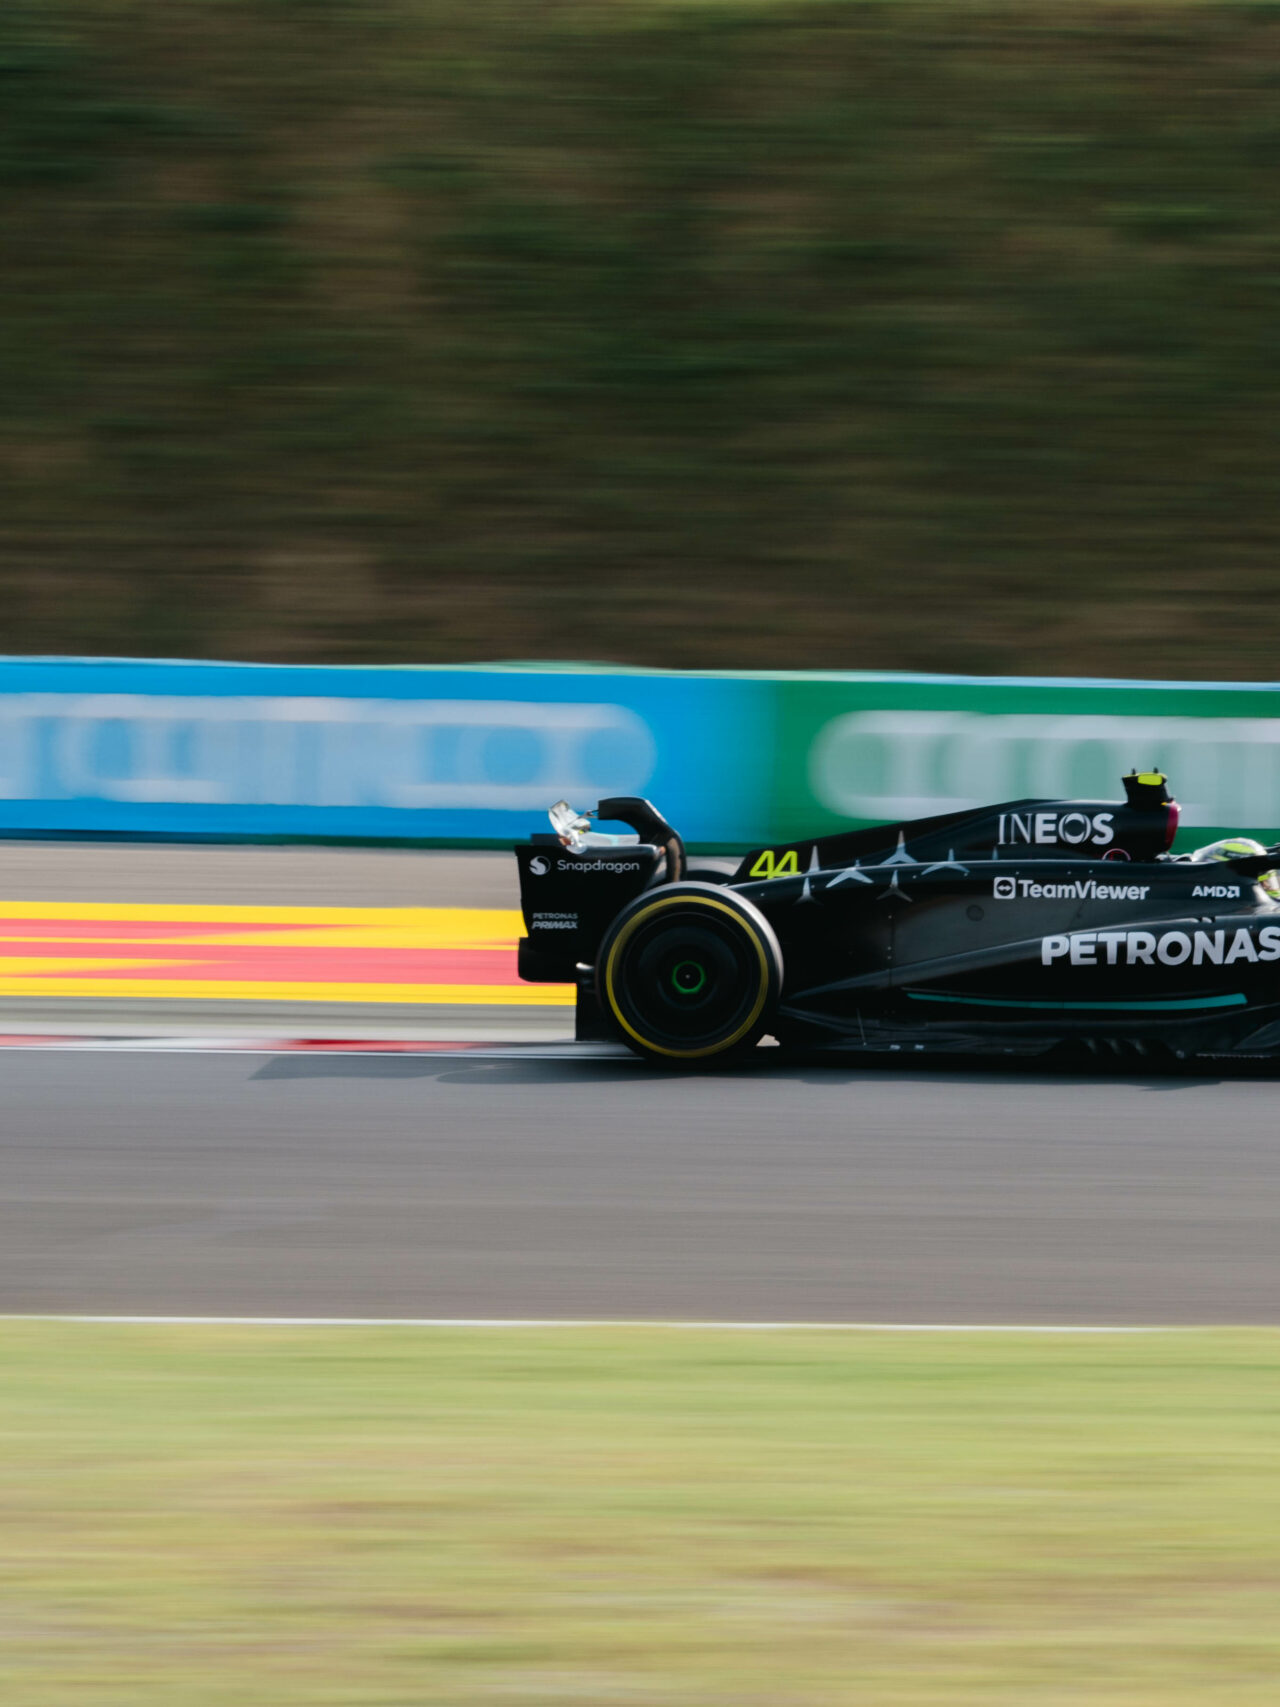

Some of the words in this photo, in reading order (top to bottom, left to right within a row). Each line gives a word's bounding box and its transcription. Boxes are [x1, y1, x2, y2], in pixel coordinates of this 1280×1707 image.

[998, 813, 1114, 845] INEOS
[557, 860, 640, 873] Snapdragon
[749, 850, 801, 879] 44
[1018, 879, 1150, 900] TeamViewer
[1192, 885, 1228, 898] AMD
[532, 921, 578, 929] PRIMAX
